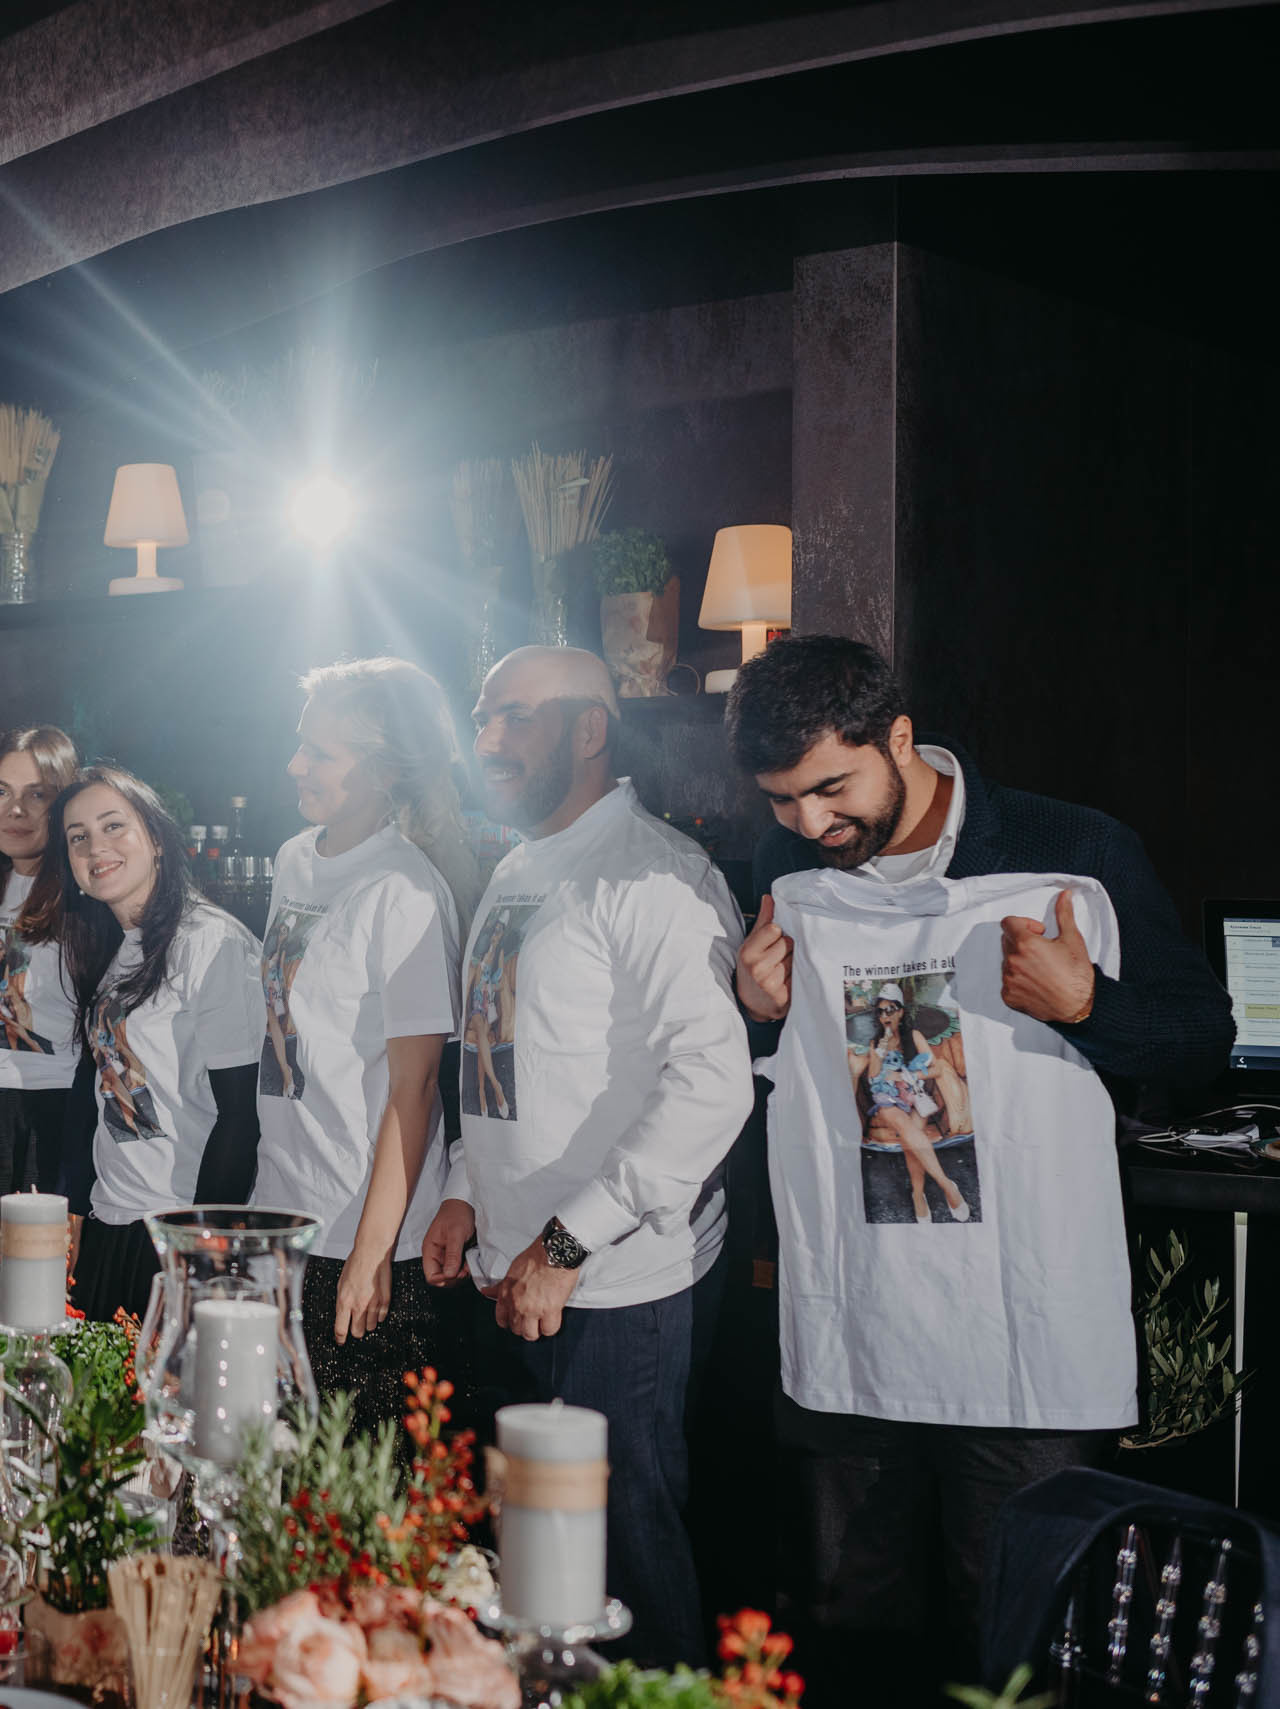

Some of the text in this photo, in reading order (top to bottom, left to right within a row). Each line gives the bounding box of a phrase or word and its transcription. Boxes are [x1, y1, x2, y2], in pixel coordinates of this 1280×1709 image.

[842, 956, 956, 977] The winner takes it all
